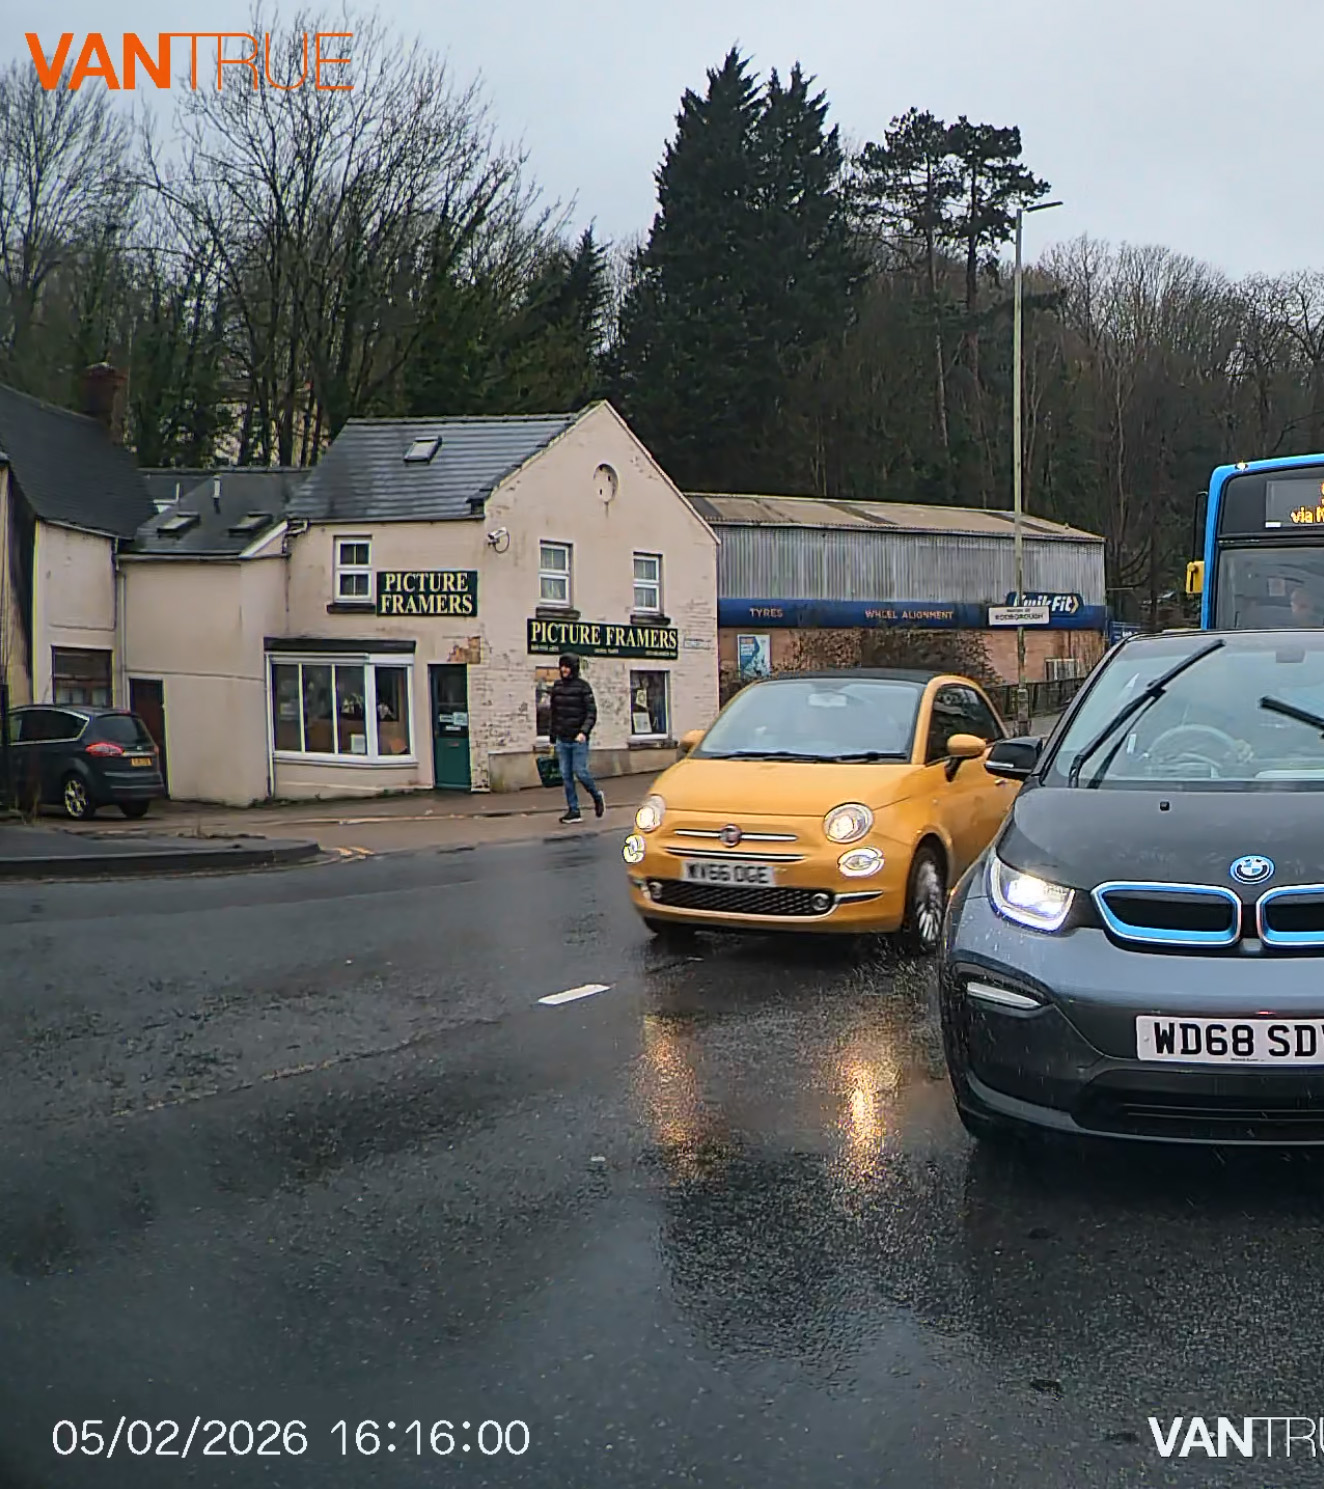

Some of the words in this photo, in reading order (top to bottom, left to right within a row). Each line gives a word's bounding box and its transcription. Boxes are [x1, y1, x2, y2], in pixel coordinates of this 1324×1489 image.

[1291, 509, 1313, 523] via
[384, 572, 469, 592] PICTURE
[380, 594, 473, 615] FRAMERS
[1051, 595, 1072, 612] Fit
[750, 608, 783, 618] TYRES
[865, 609, 898, 619] WHEEL
[902, 610, 954, 620] ALIGNMENT
[530, 621, 601, 645] PICTURE
[605, 624, 677, 649] FRAMERS
[1154, 1022, 1254, 1057] WD68
